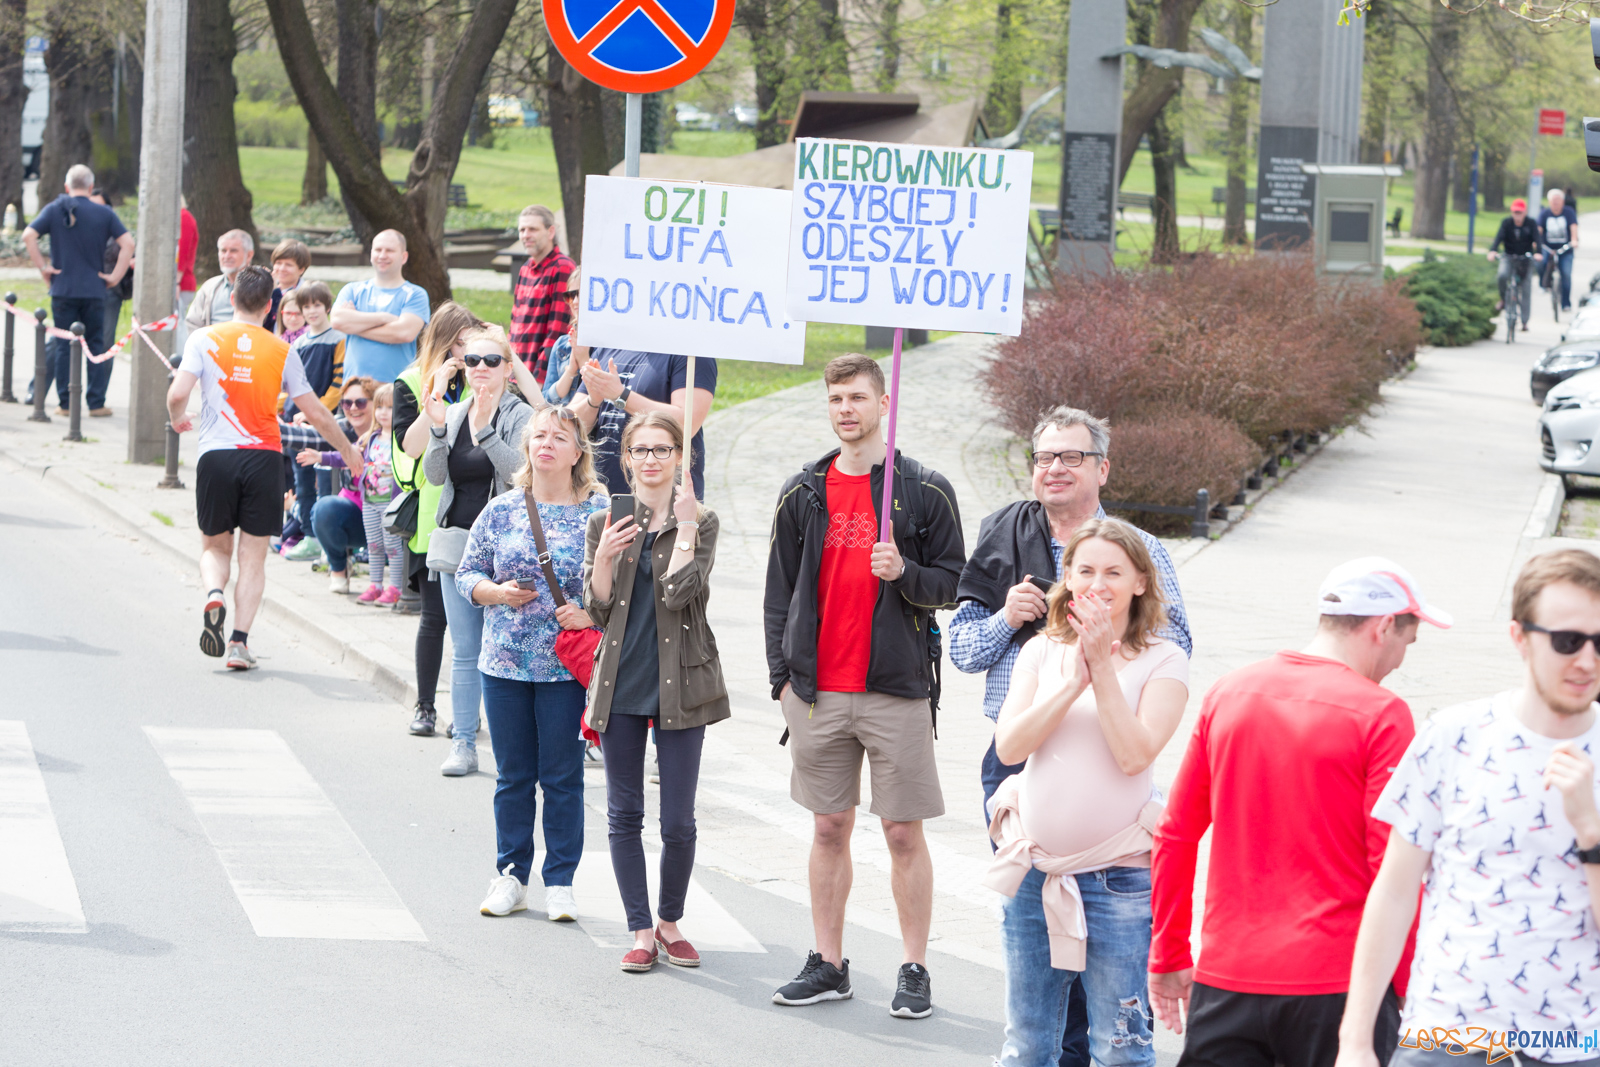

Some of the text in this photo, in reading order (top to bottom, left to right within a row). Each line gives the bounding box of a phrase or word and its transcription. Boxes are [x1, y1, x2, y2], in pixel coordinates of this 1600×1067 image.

[798, 142, 1012, 193] KIEROWNIKU,
[624, 223, 733, 268] LUFA
[802, 222, 964, 267] ODESZŁY
[587, 276, 634, 314] DO
[807, 264, 1012, 313] JEJ WODY!
